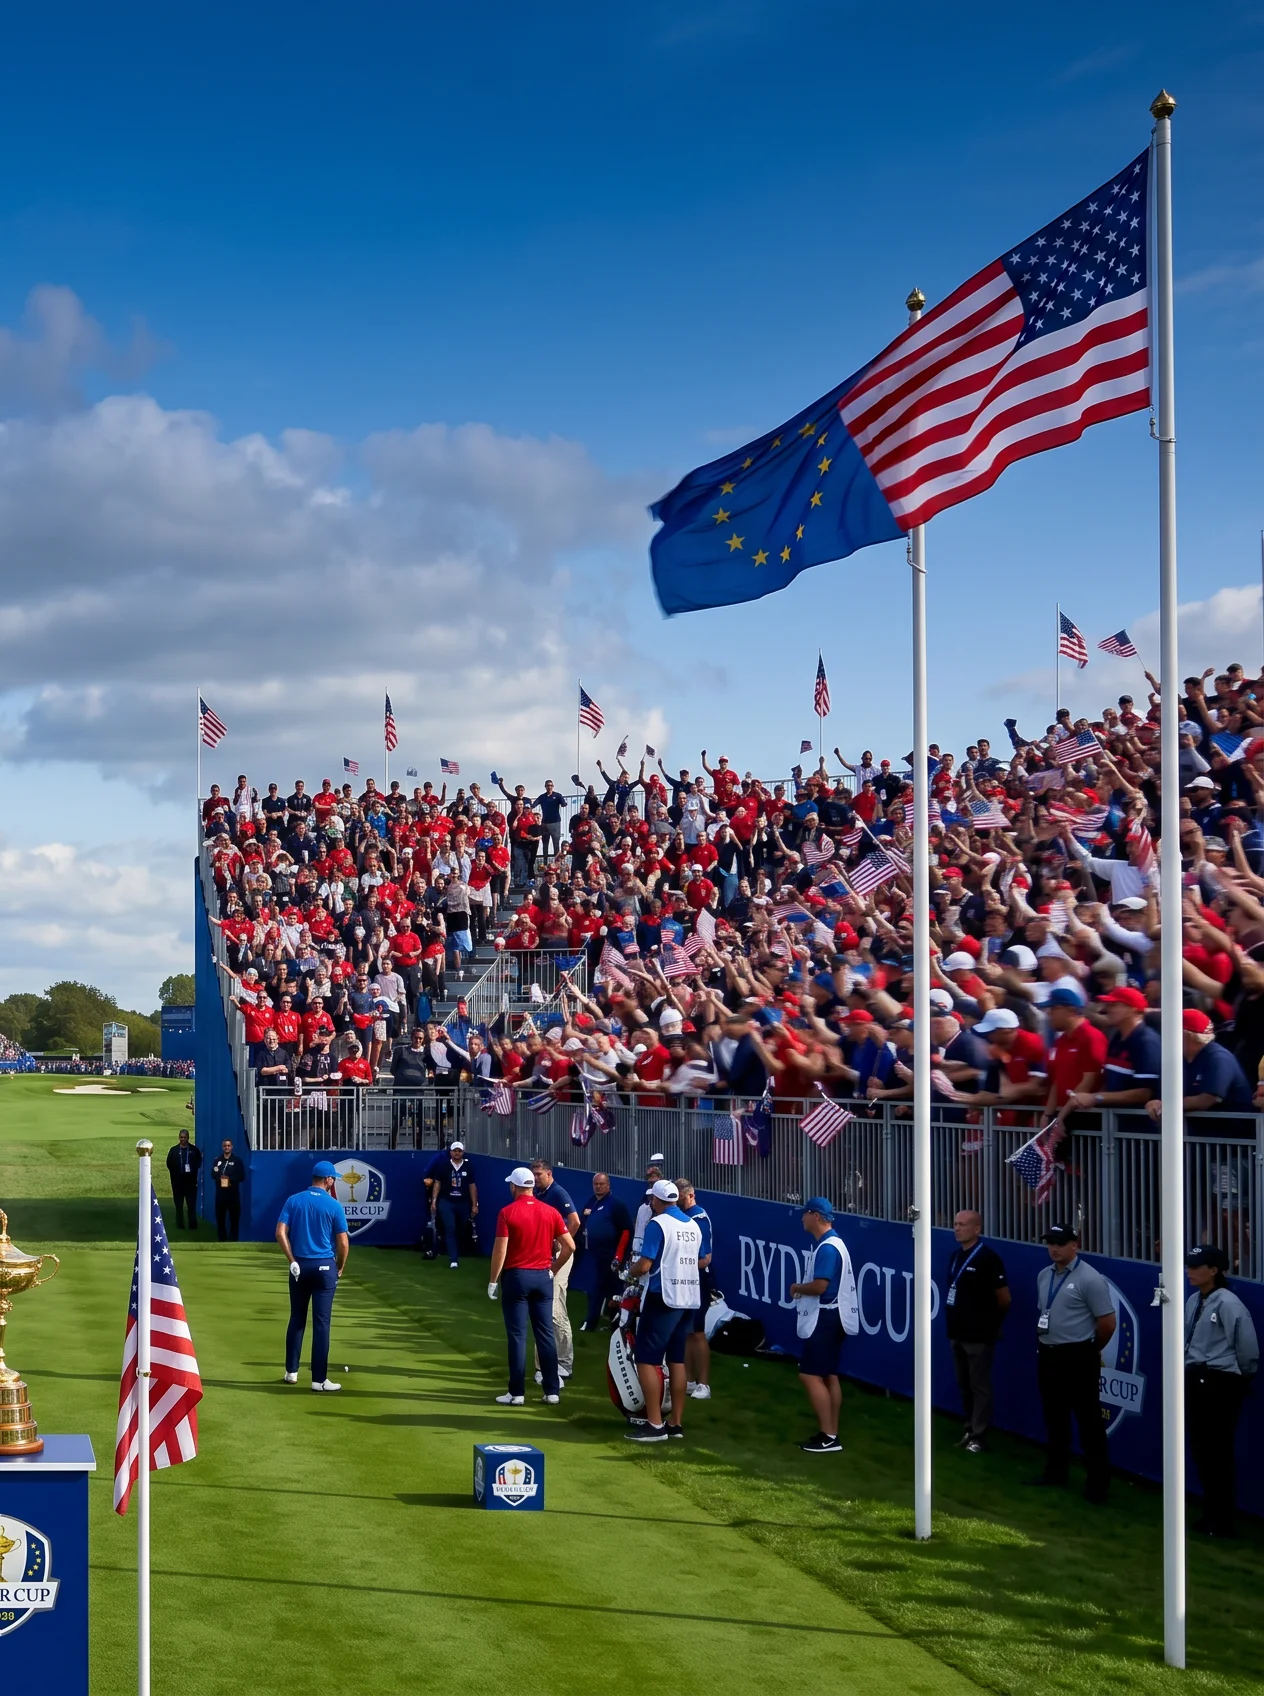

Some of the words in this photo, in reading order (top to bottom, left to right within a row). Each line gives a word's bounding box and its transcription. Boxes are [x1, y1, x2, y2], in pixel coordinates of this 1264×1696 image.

[359, 1205, 384, 1216] CUP
[738, 1235, 814, 1310] RYD
[1109, 1378, 1139, 1402] CUP
[13, 1588, 51, 1602] CUP
